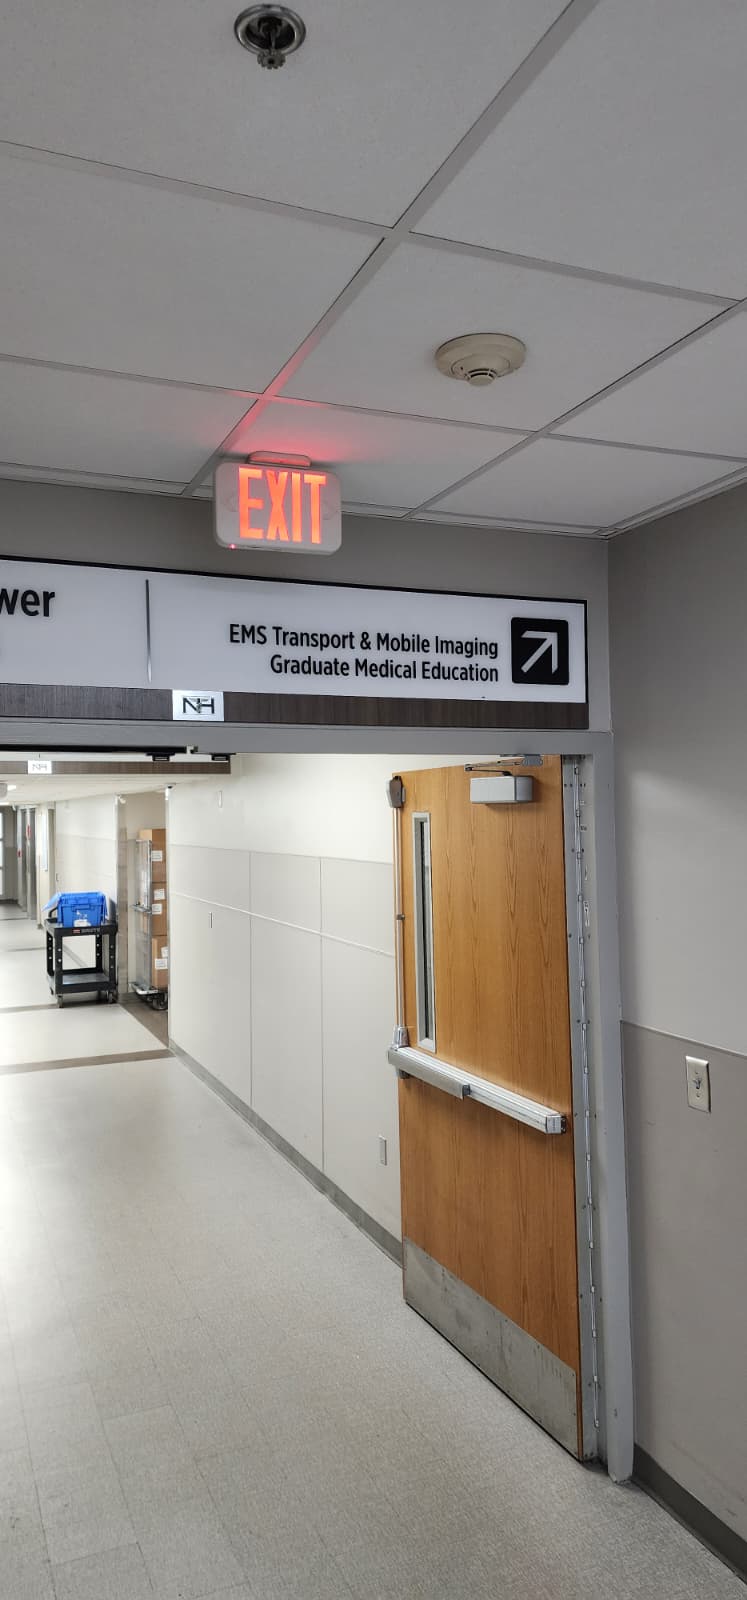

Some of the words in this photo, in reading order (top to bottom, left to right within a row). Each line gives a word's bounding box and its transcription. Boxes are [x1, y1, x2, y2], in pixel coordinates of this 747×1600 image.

[238, 467, 327, 544] EXIT
[229, 623, 267, 645] EMS
[272, 626, 355, 651] Transport
[360, 631, 371, 650] &
[376, 632, 430, 653] Mobile
[435, 635, 498, 659] Imaging
[270, 654, 349, 677] Graduate
[355, 658, 417, 679] Medical
[421, 661, 499, 682] Education
